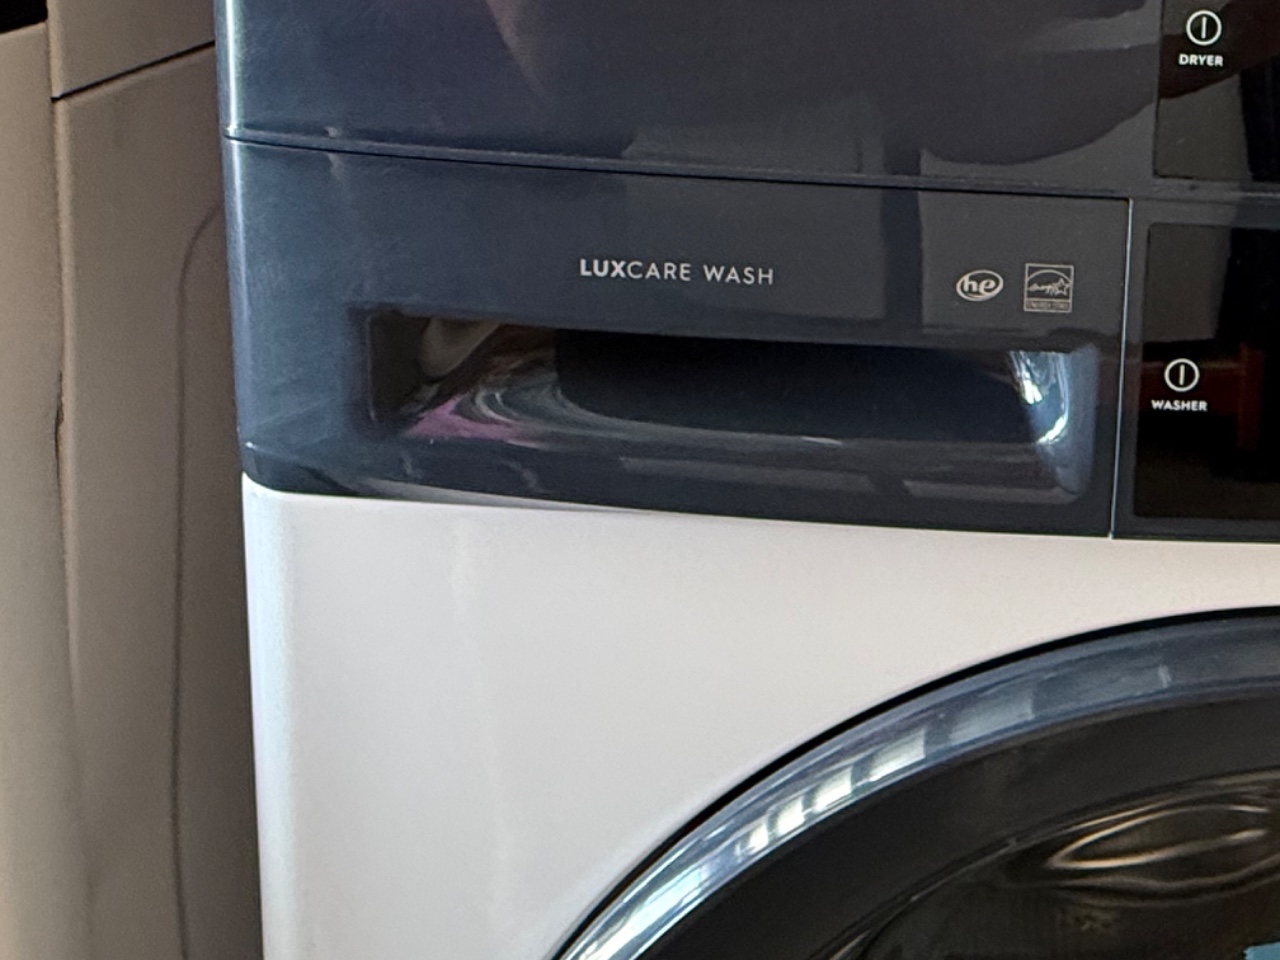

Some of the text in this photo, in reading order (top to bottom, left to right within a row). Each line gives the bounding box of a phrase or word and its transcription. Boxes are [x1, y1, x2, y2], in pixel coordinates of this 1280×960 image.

[1178, 52, 1224, 67] DRYER
[579, 257, 774, 285] LUXCARE WASH
[963, 275, 995, 296] he
[1151, 399, 1208, 413] WASHER
